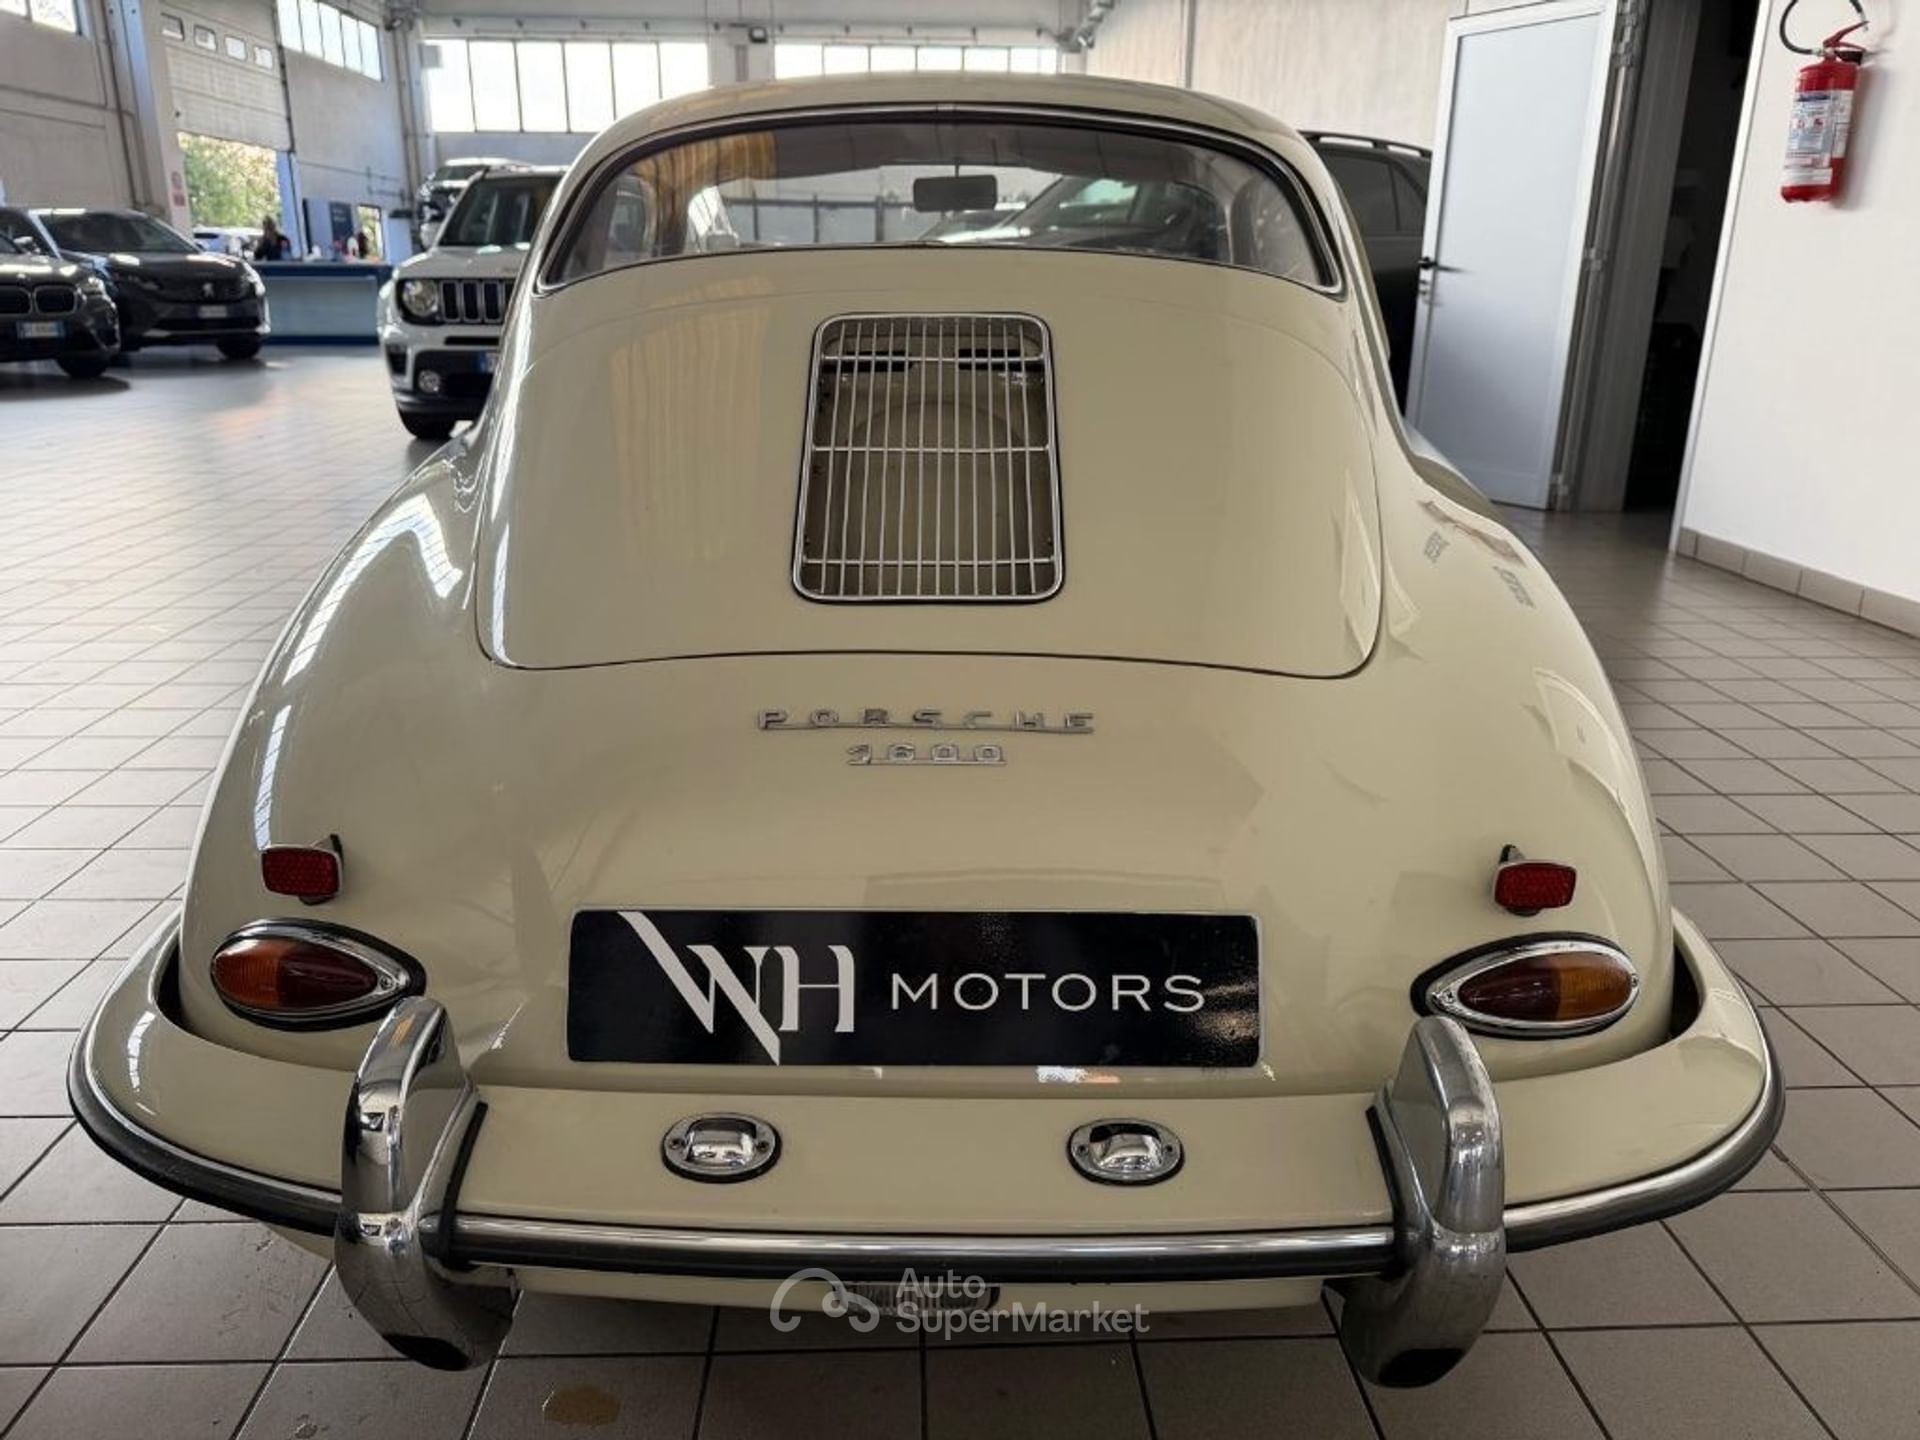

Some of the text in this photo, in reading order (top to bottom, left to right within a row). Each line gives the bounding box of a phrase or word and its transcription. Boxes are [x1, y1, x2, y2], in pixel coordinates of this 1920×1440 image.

[757, 709, 1094, 734] PORSCHE
[847, 744, 1007, 766] 1600
[617, 911, 1206, 1066] WH MOTORS
